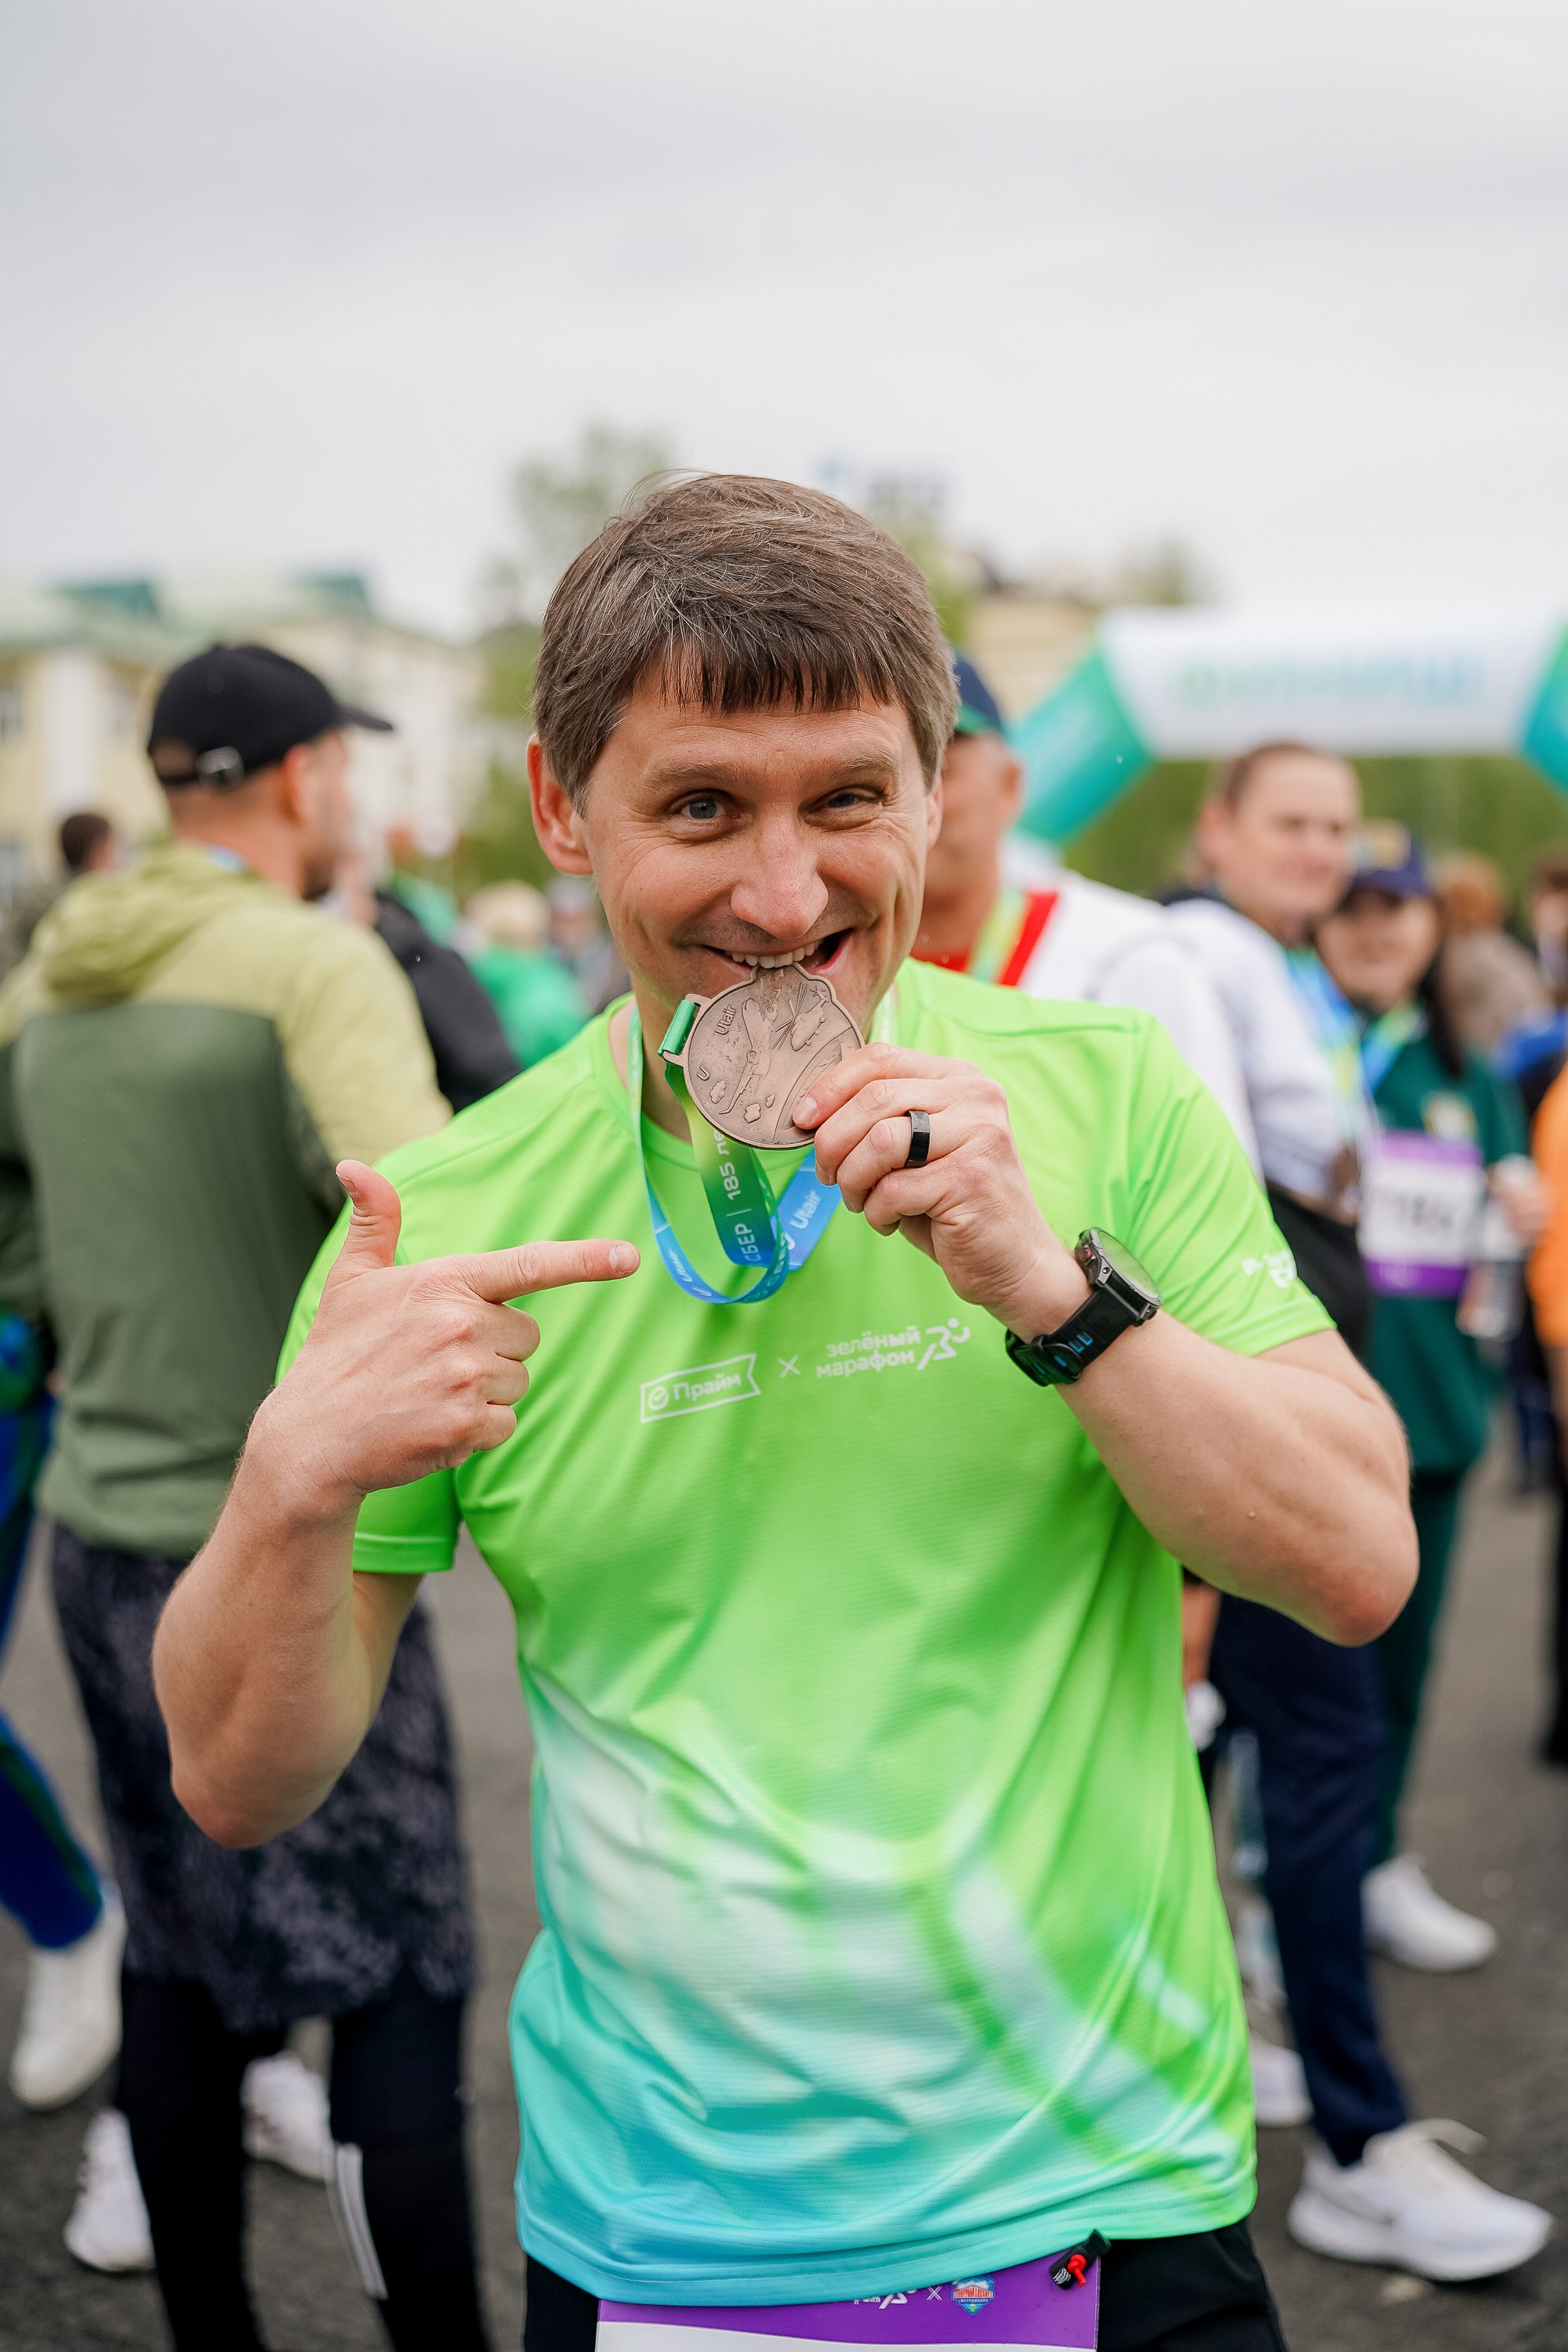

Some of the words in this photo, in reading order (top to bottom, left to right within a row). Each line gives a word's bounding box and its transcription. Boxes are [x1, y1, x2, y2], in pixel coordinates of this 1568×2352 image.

[714, 1004, 737, 1035] Utair
[719, 1162, 741, 1200] 185
[734, 1223, 761, 1261] СБЕР
[826, 1325, 921, 1358] зелёный
[816, 1348, 915, 1378] марафон
[673, 1374, 741, 1402] Прайм
